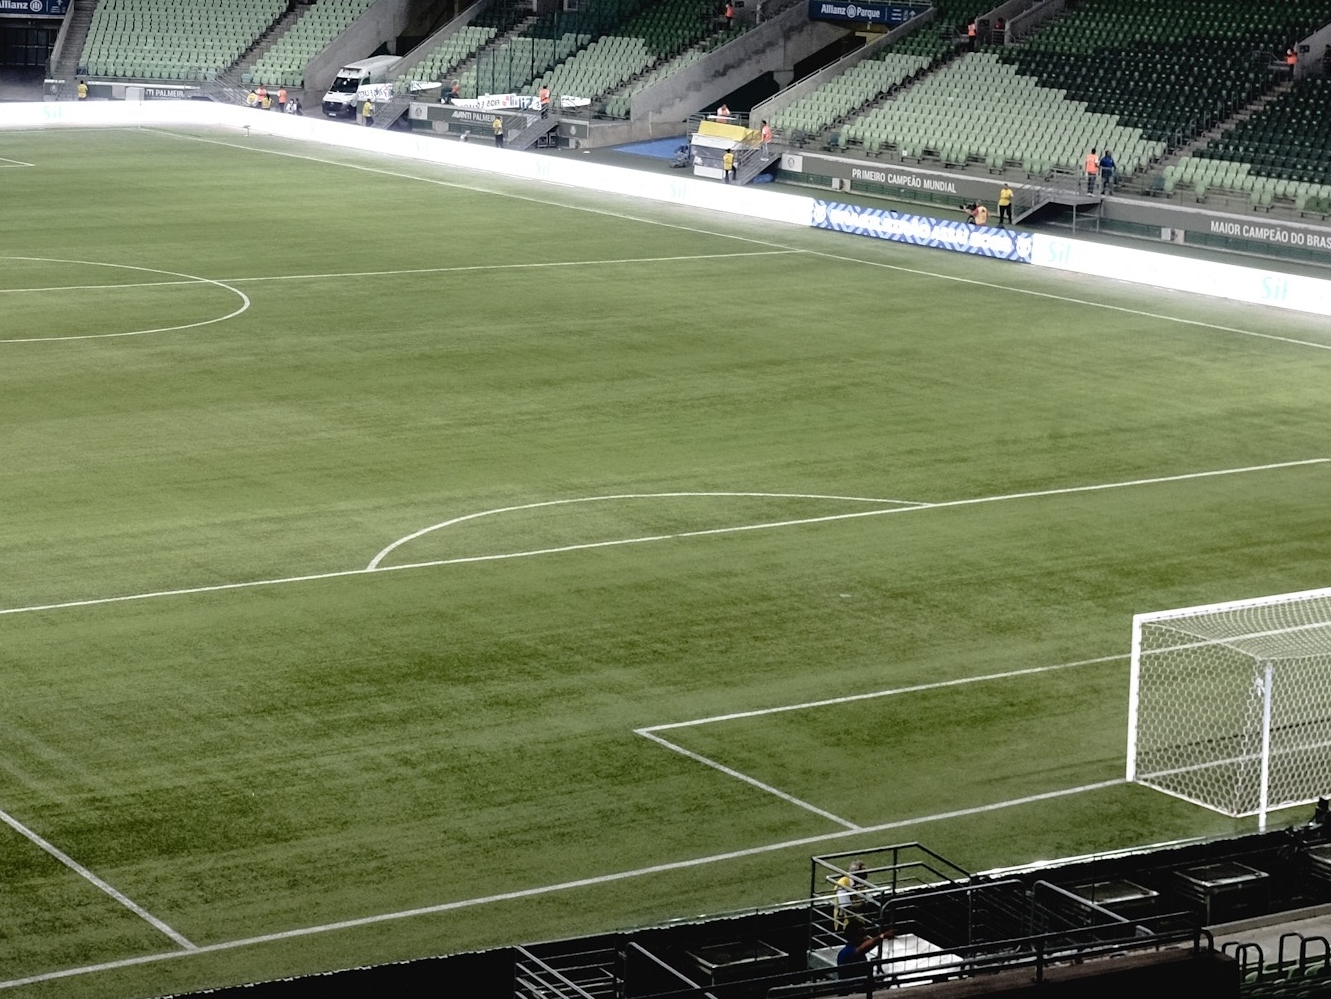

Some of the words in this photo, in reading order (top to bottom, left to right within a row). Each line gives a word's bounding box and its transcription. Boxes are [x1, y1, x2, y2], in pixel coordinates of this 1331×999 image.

[821, 4, 846, 15] Allianz
[857, 6, 880, 20] Parque
[852, 168, 885, 183] PRIMEIRO
[887, 173, 921, 188] CAMPEÃO
[923, 179, 957, 194] MUNDIAL
[1210, 220, 1240, 235] MAIOR
[1242, 225, 1288, 242] CAMPEÃO
[1290, 232, 1304, 244] DO
